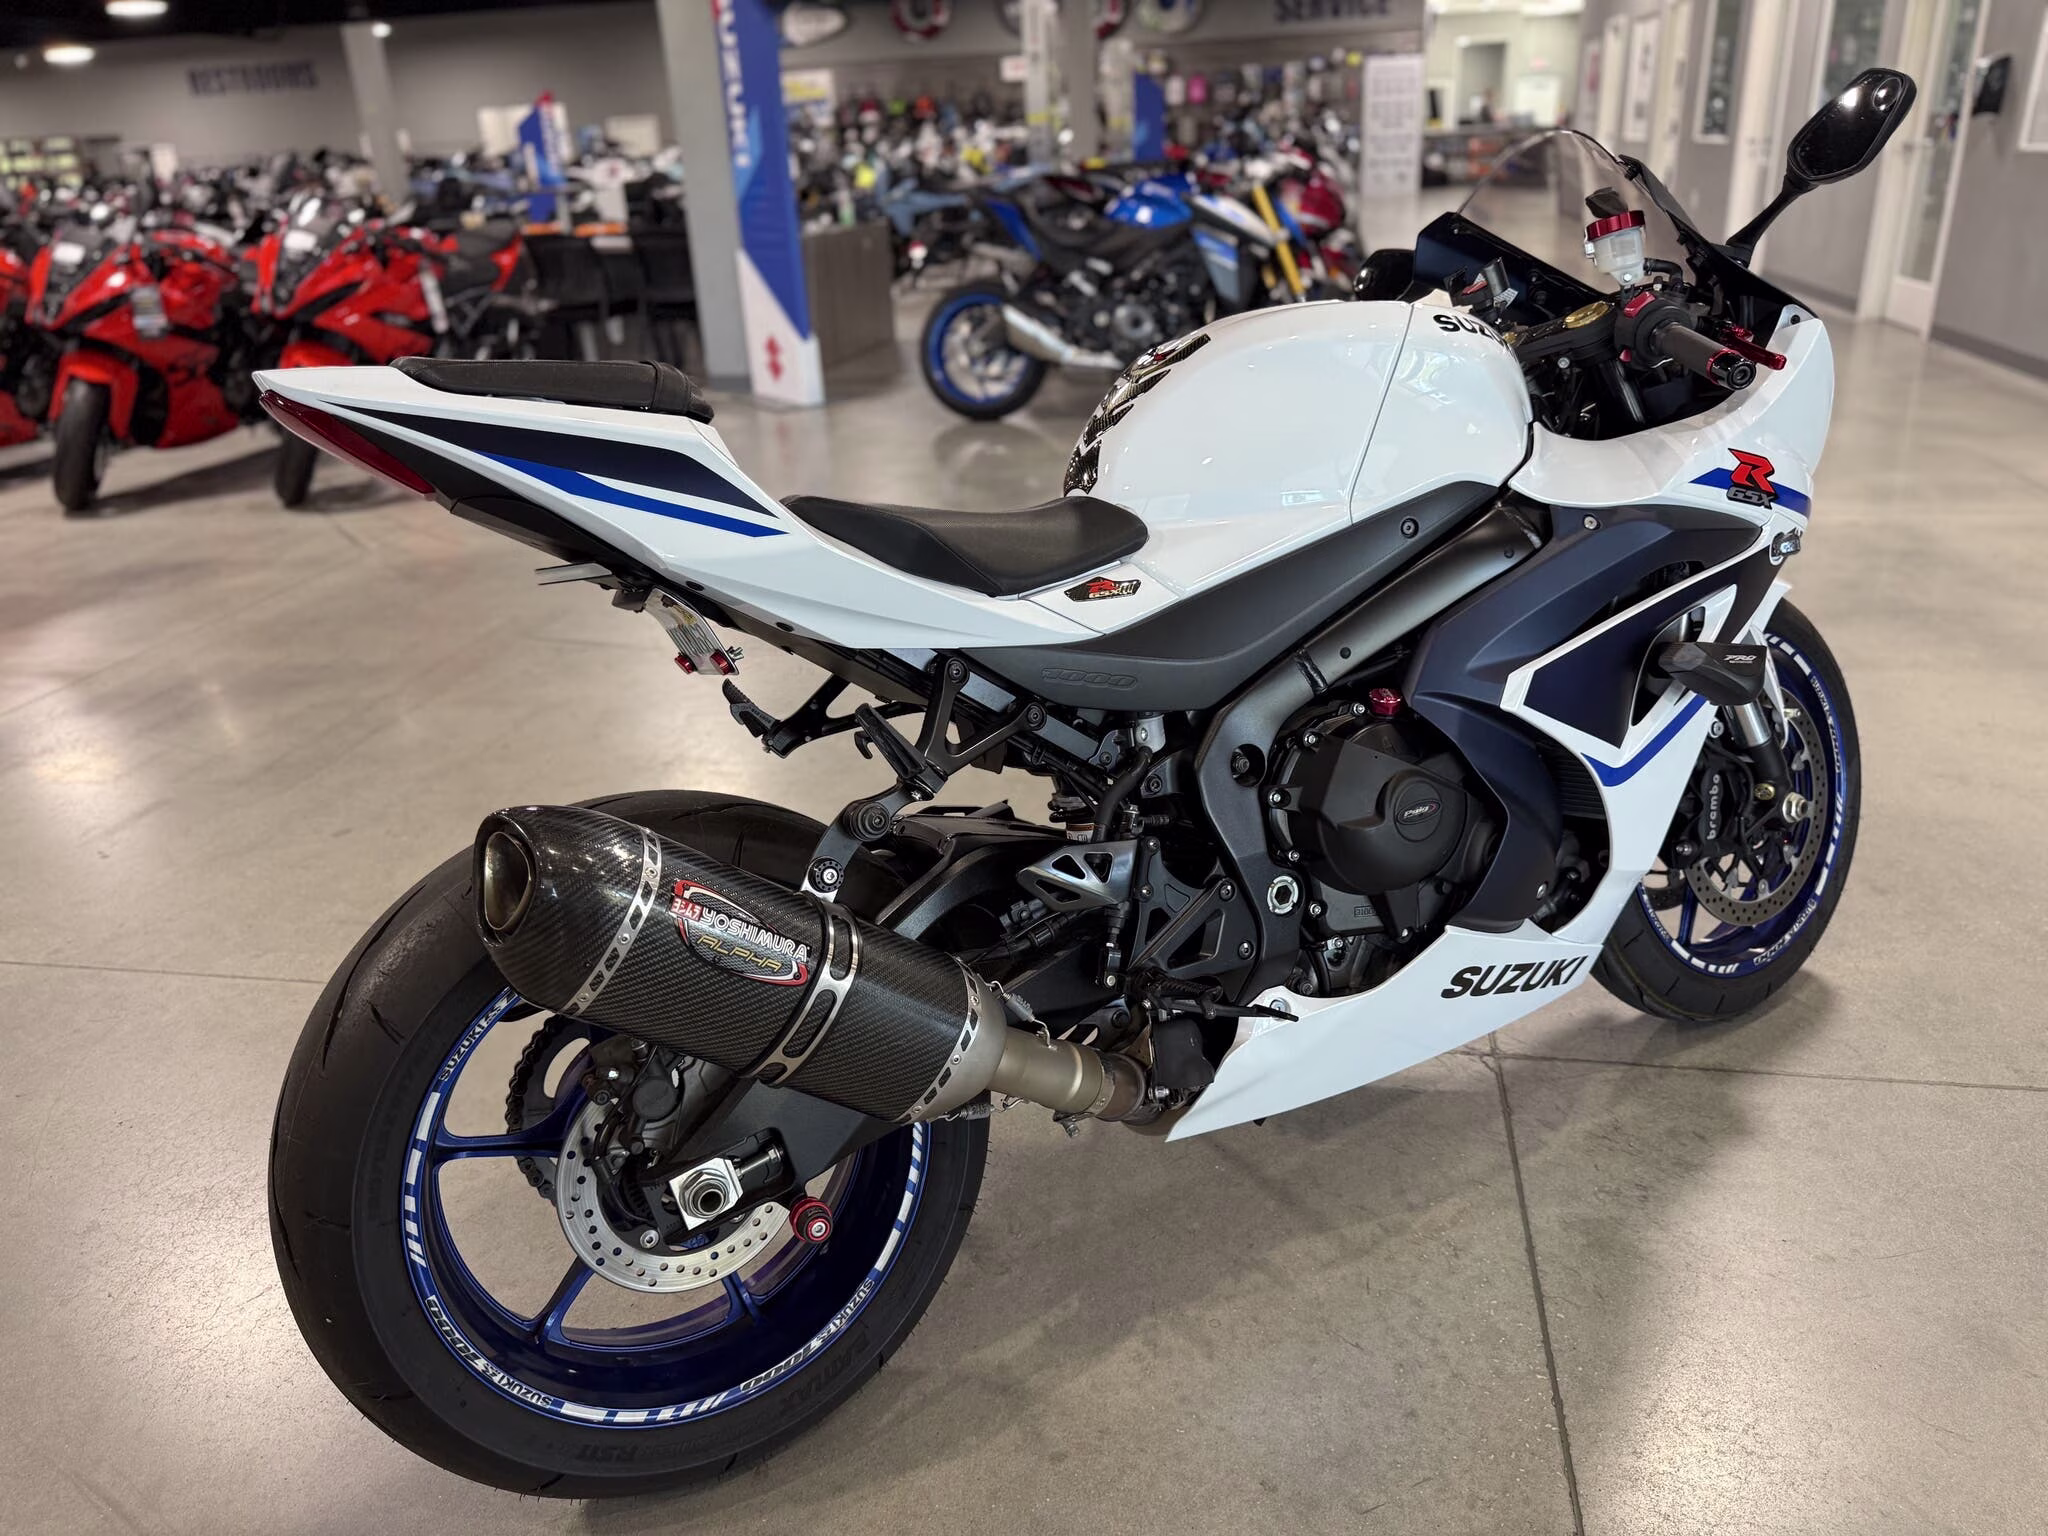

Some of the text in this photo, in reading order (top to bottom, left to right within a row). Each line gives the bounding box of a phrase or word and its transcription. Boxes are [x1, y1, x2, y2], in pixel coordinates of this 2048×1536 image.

[1728, 448, 1775, 494] R
[1730, 487, 1773, 508] GSX
[1706, 773, 1721, 840] brembo
[697, 936, 782, 972] ALPHA
[701, 907, 807, 963] YOSHIMURA
[1441, 955, 1588, 999] SUZUKI
[438, 1020, 485, 1081] SUZUKI
[831, 1278, 876, 1331] SUZUKI
[426, 1297, 482, 1367] 1000
[497, 1374, 553, 1408] SUZUKI
[741, 1343, 817, 1392] 1000
